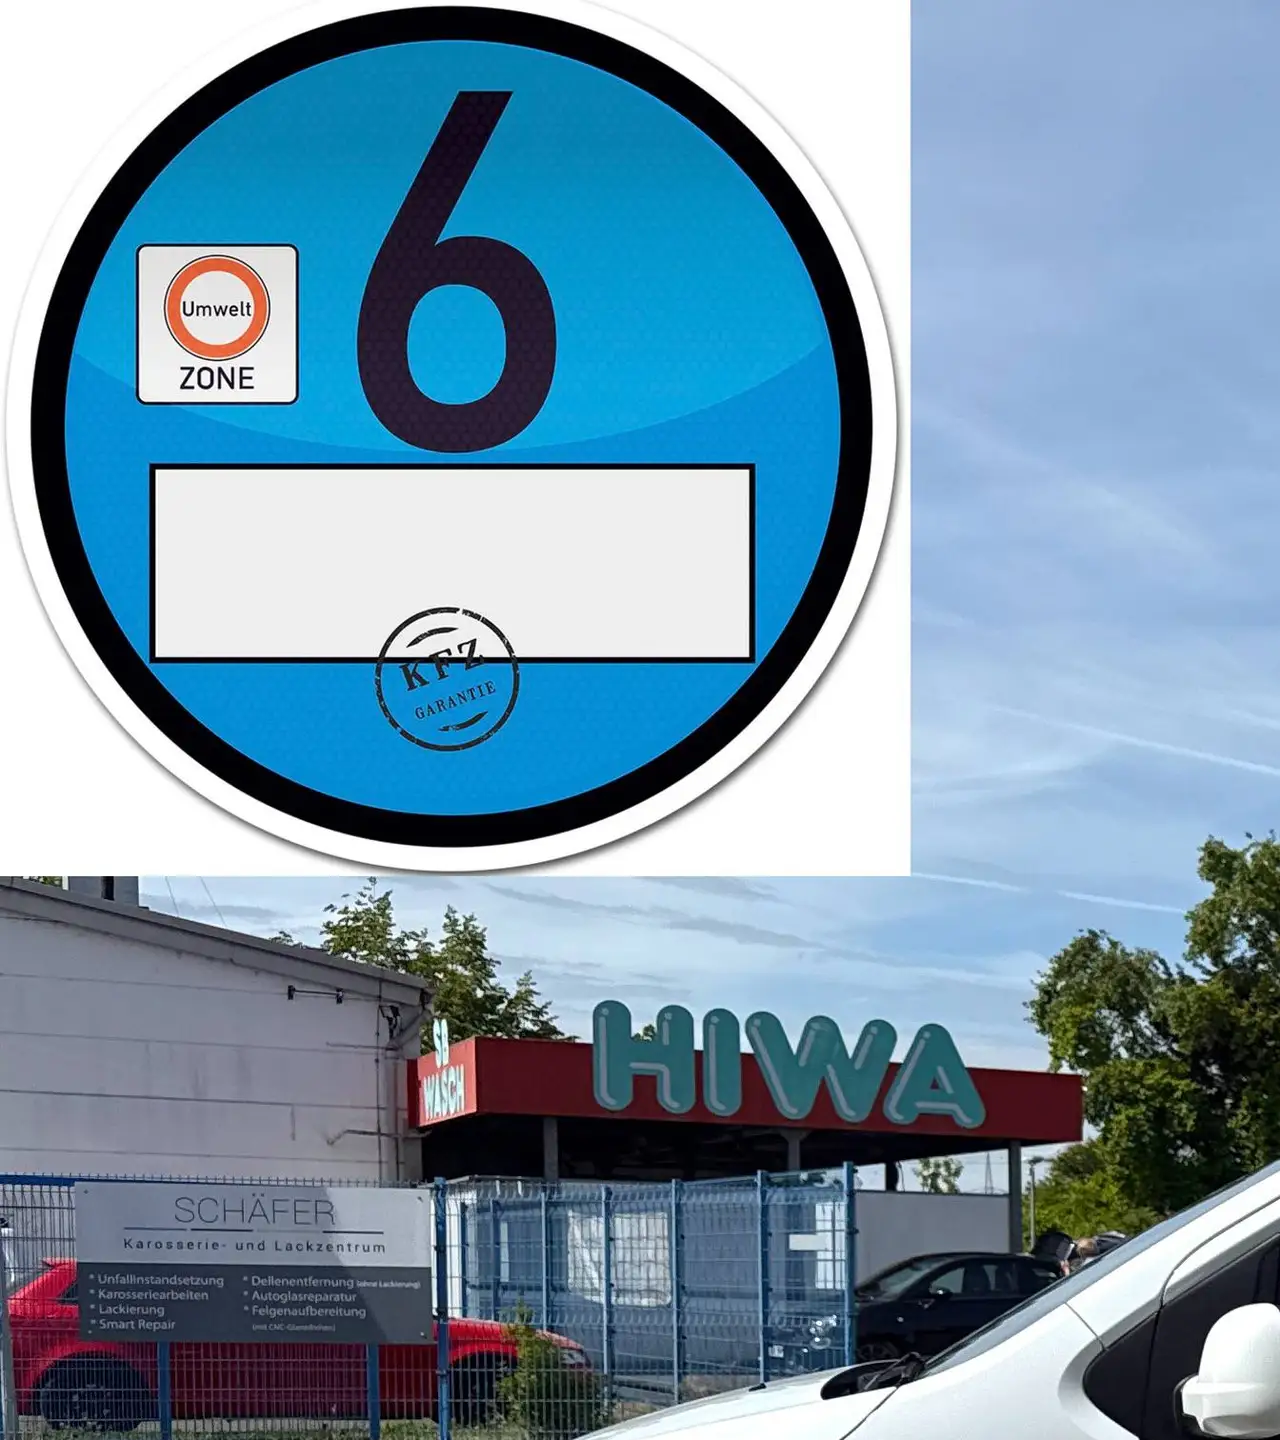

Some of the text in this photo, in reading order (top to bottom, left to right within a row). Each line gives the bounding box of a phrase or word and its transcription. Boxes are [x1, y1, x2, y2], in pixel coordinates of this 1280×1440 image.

[592, 1000, 987, 1130] HIWA
[422, 1063, 466, 1121] WASCH
[174, 1192, 336, 1226] SCHÄFER
[123, 1238, 386, 1254] Karosserie- und Lackzentrum
[97, 1273, 225, 1288] Unfallinstandsetzung
[251, 1275, 354, 1290] Dellenentfernung
[98, 1288, 210, 1301] Karosseriearbeiten
[252, 1290, 358, 1304] Autoglasreparatur
[99, 1303, 165, 1318] Lackierung
[252, 1304, 367, 1320] Felgenaufbereitung
[99, 1318, 176, 1332] Smart Repair
